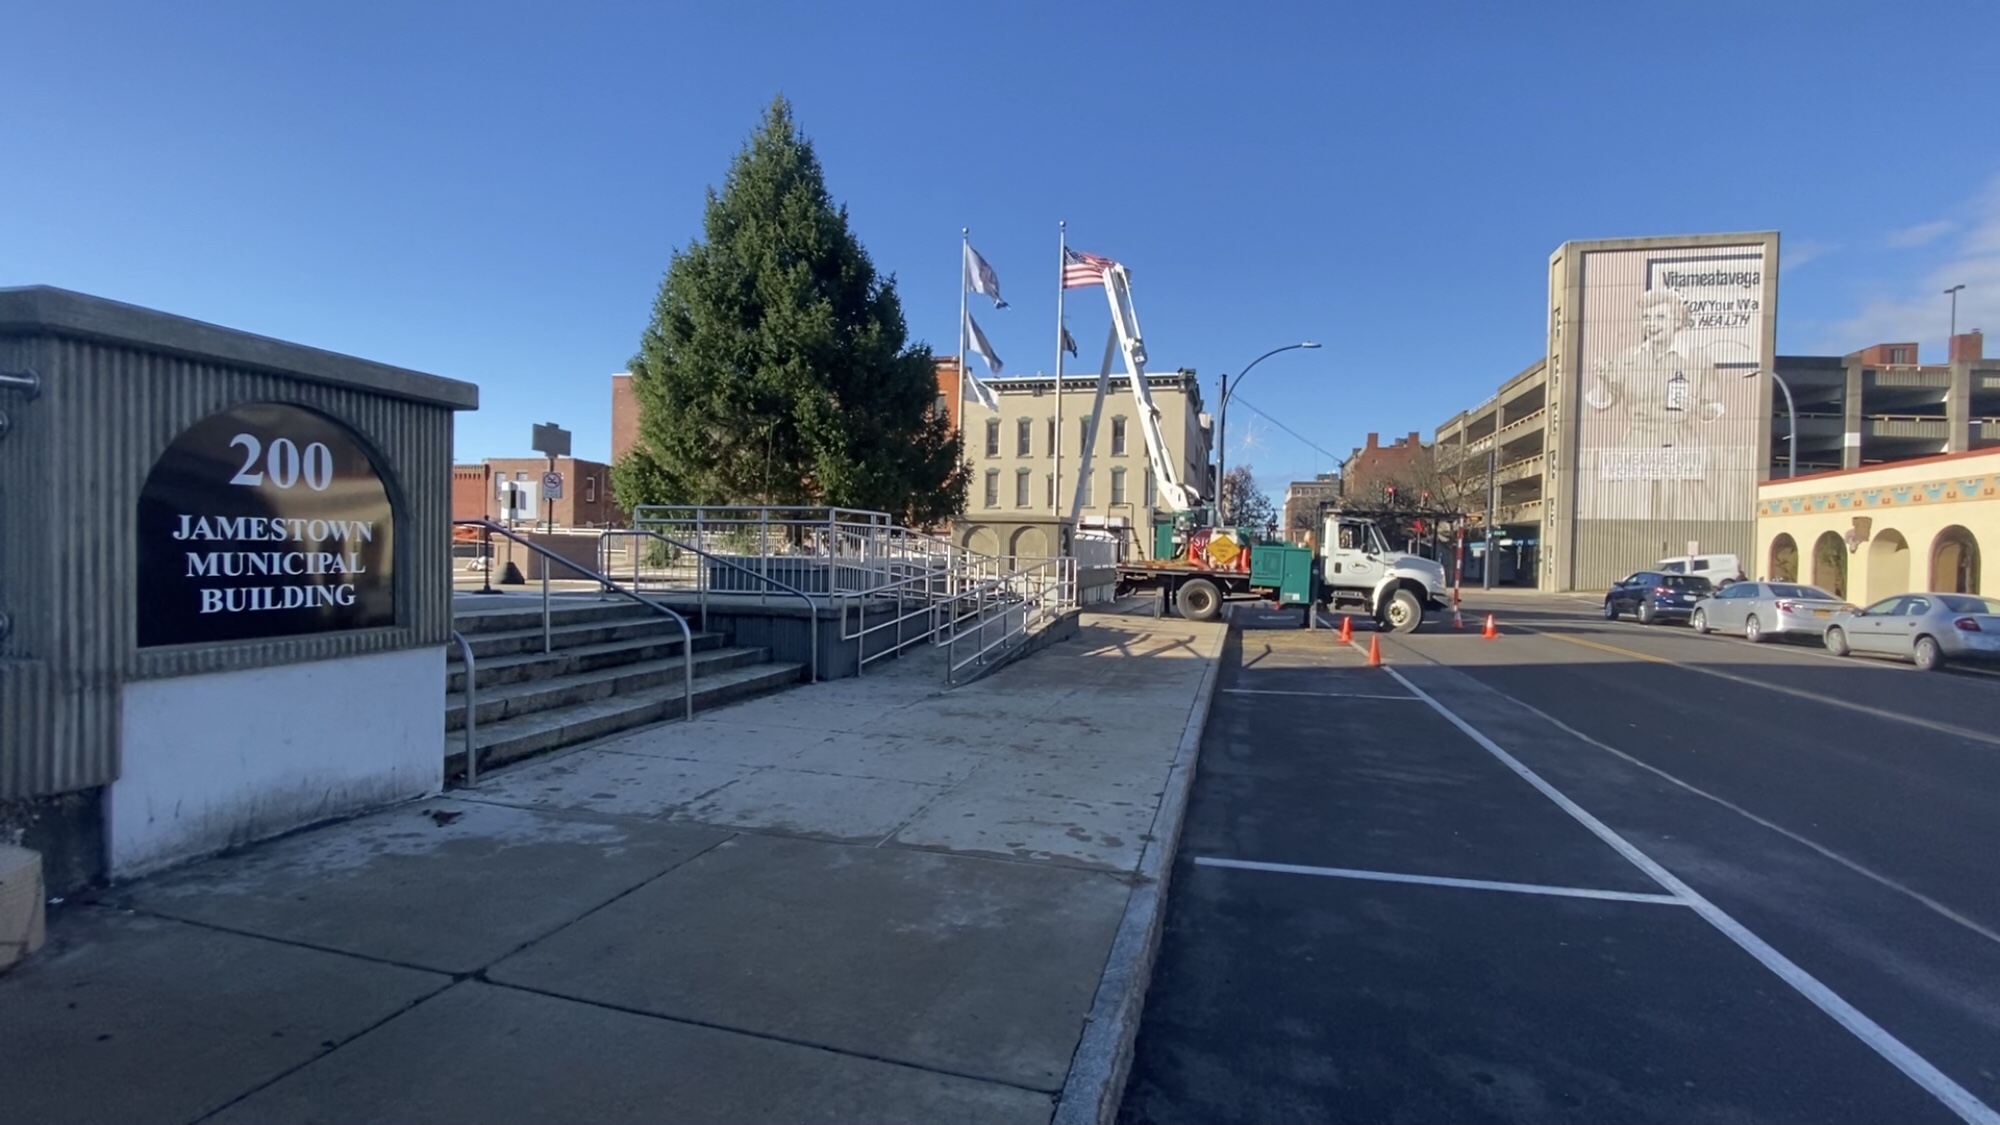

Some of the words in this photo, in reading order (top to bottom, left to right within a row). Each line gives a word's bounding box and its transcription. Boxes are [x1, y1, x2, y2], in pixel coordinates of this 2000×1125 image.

[1662, 270, 1761, 289] Vitameatavega
[1708, 299, 1734, 312] Your
[1699, 315, 1750, 327] HEALTH
[229, 432, 333, 492] 200
[172, 514, 373, 543] JAMESTOWN
[185, 551, 366, 577] MUNICIPAL
[199, 583, 356, 613] BUILDING
